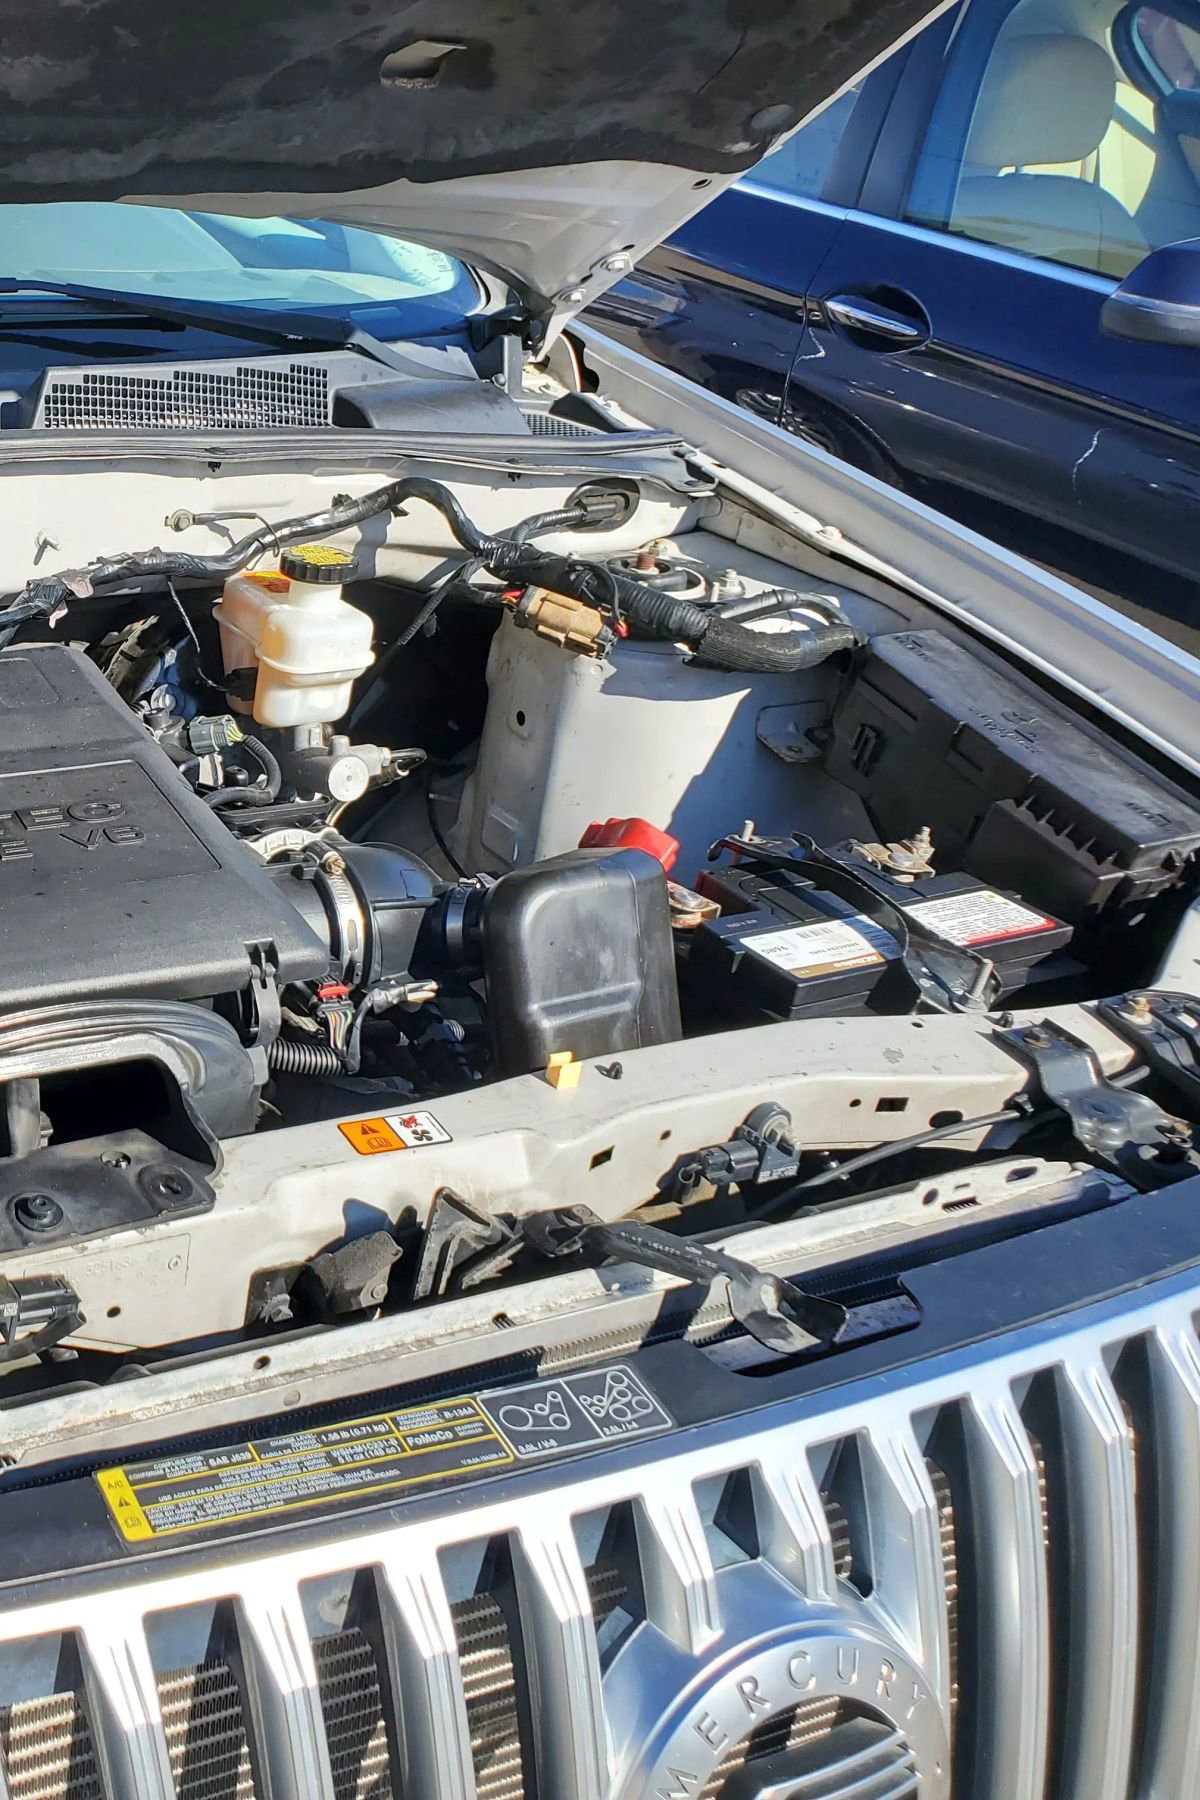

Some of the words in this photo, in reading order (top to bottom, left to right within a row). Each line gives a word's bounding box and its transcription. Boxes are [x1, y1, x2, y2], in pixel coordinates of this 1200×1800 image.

[58, 824, 147, 851] V6
[444, 1406, 474, 1419] R-134A
[408, 1428, 452, 1447] FoMoCo
[210, 1455, 229, 1467] SAE
[107, 1478, 122, 1490] A/C
[654, 1647, 927, 1800] MERCURY
